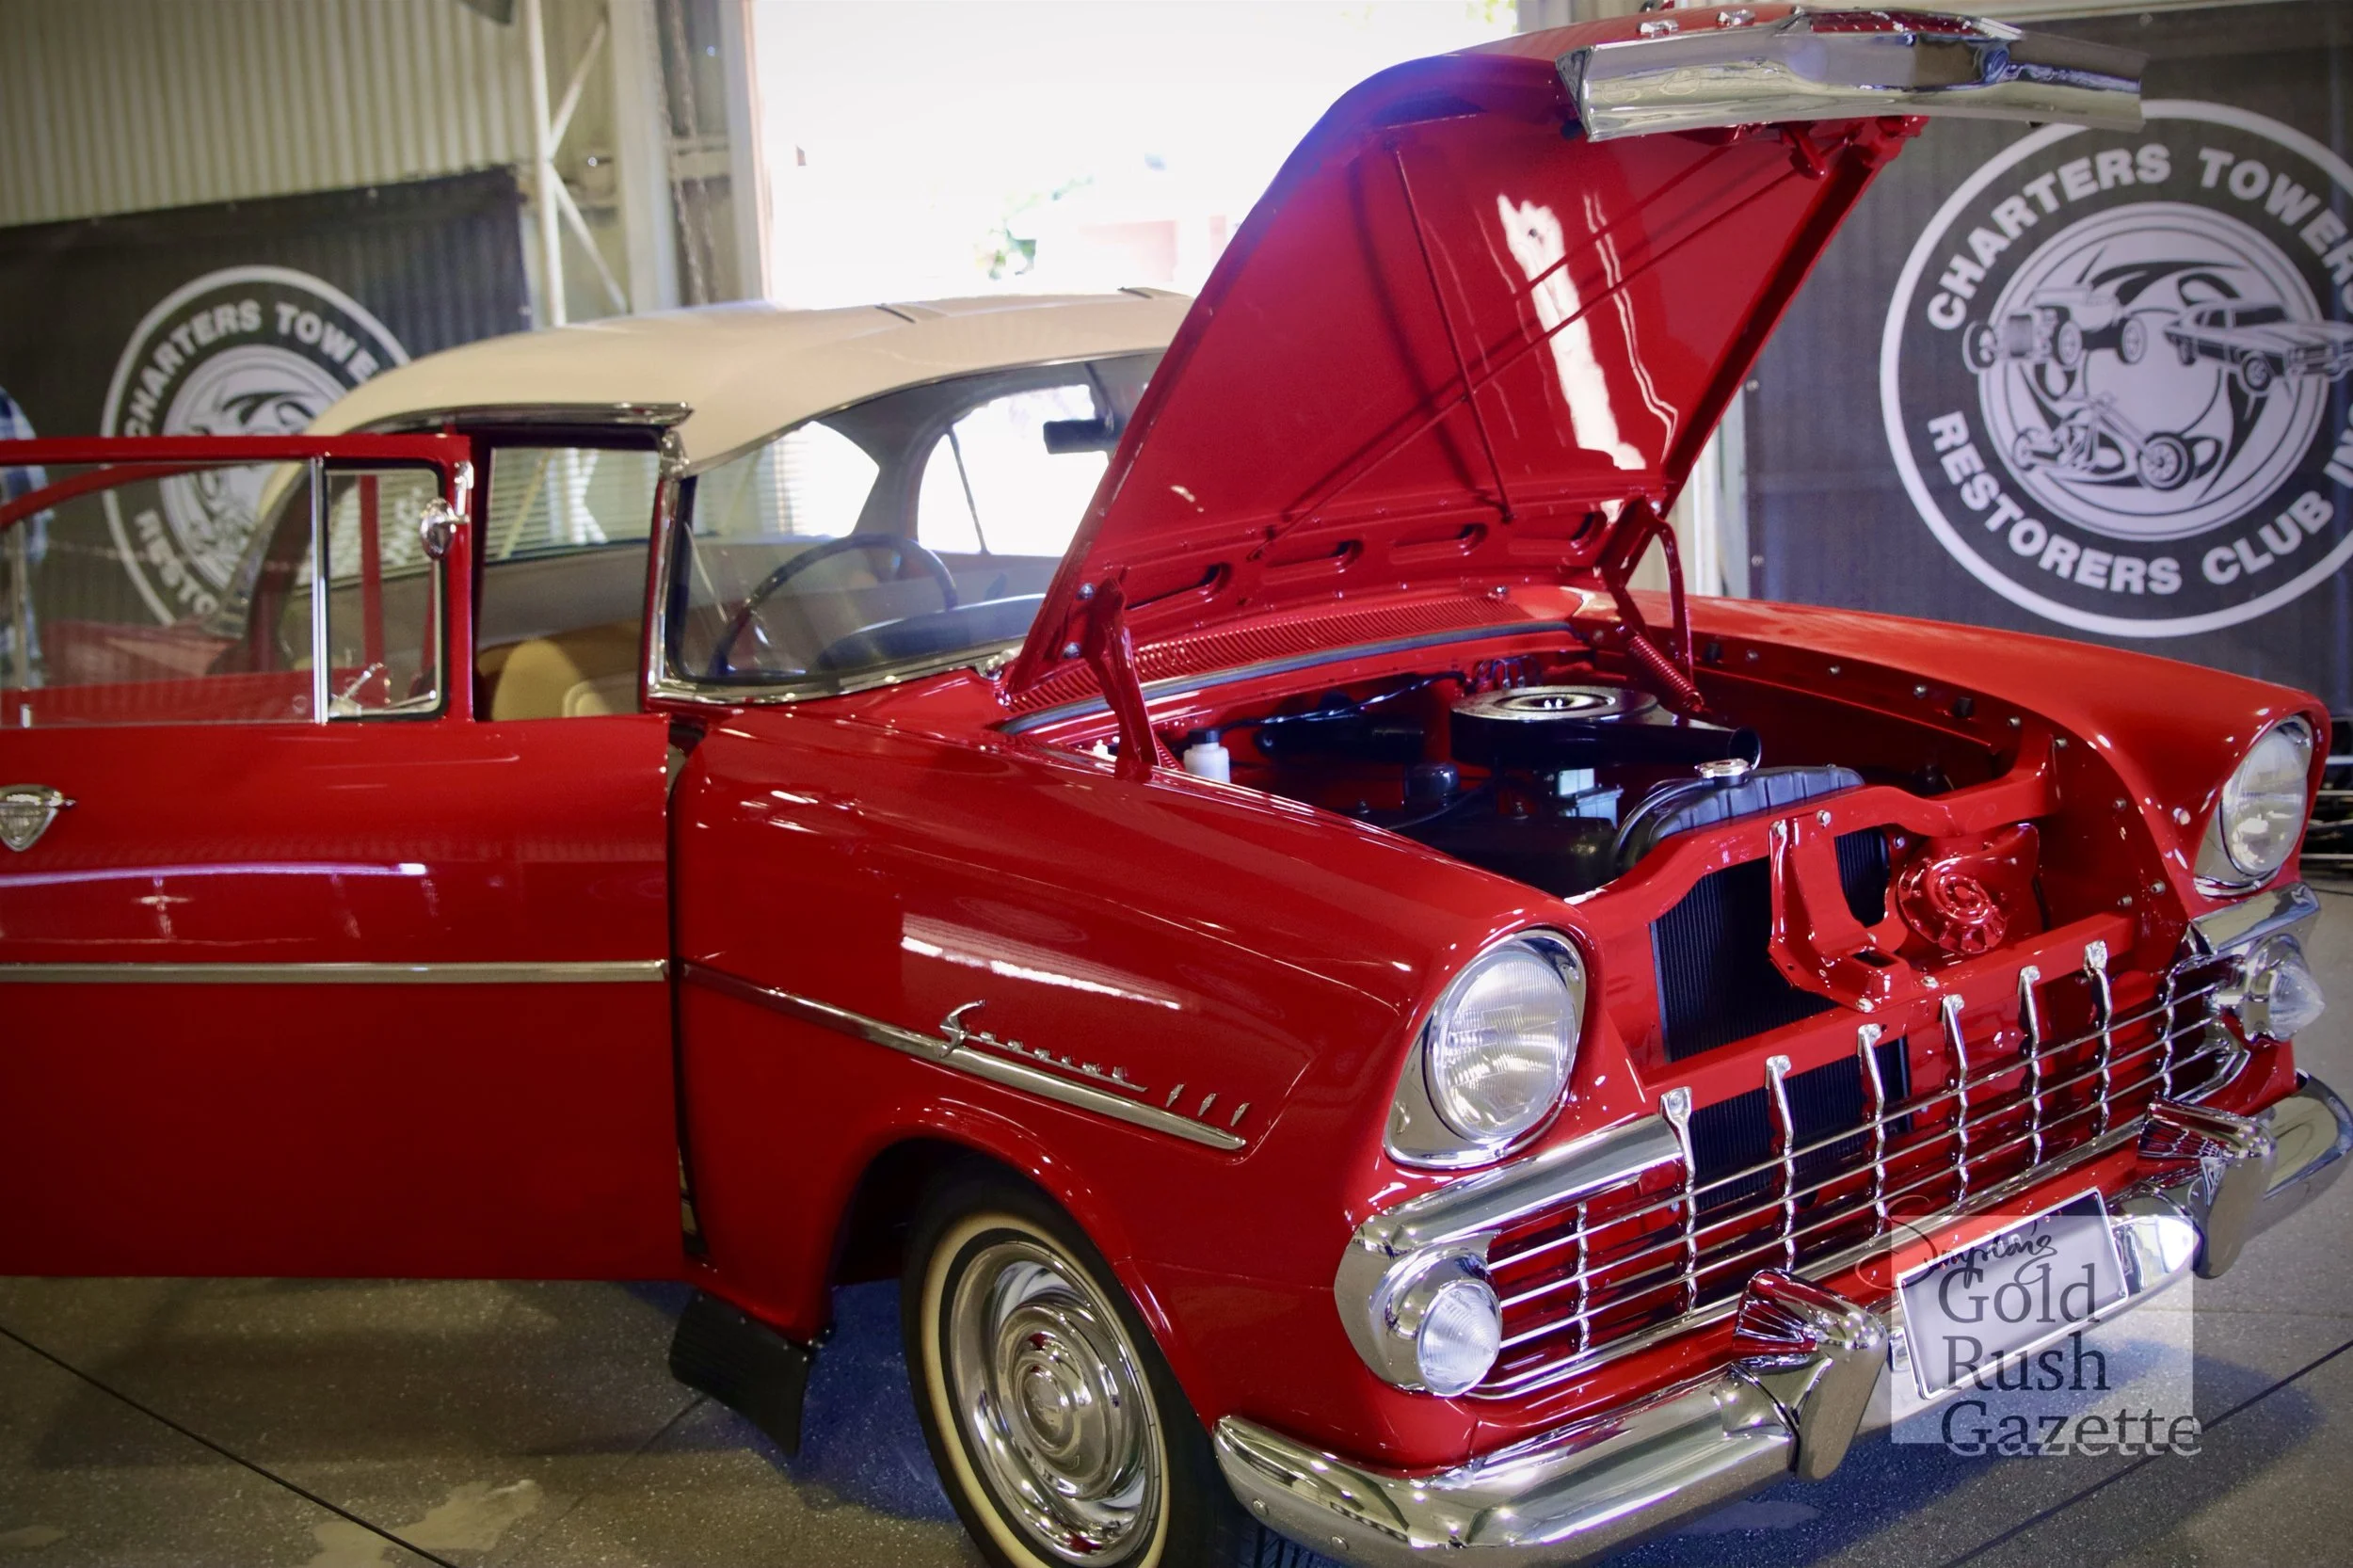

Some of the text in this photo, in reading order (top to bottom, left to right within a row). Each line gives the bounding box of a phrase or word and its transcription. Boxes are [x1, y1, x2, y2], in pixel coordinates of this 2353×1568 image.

[1927, 143, 2353, 330] CHARTERS TOWER
[275, 301, 379, 383] TOWE
[1928, 411, 2183, 595] RESTORERS
[2201, 490, 2334, 584] CLUB
